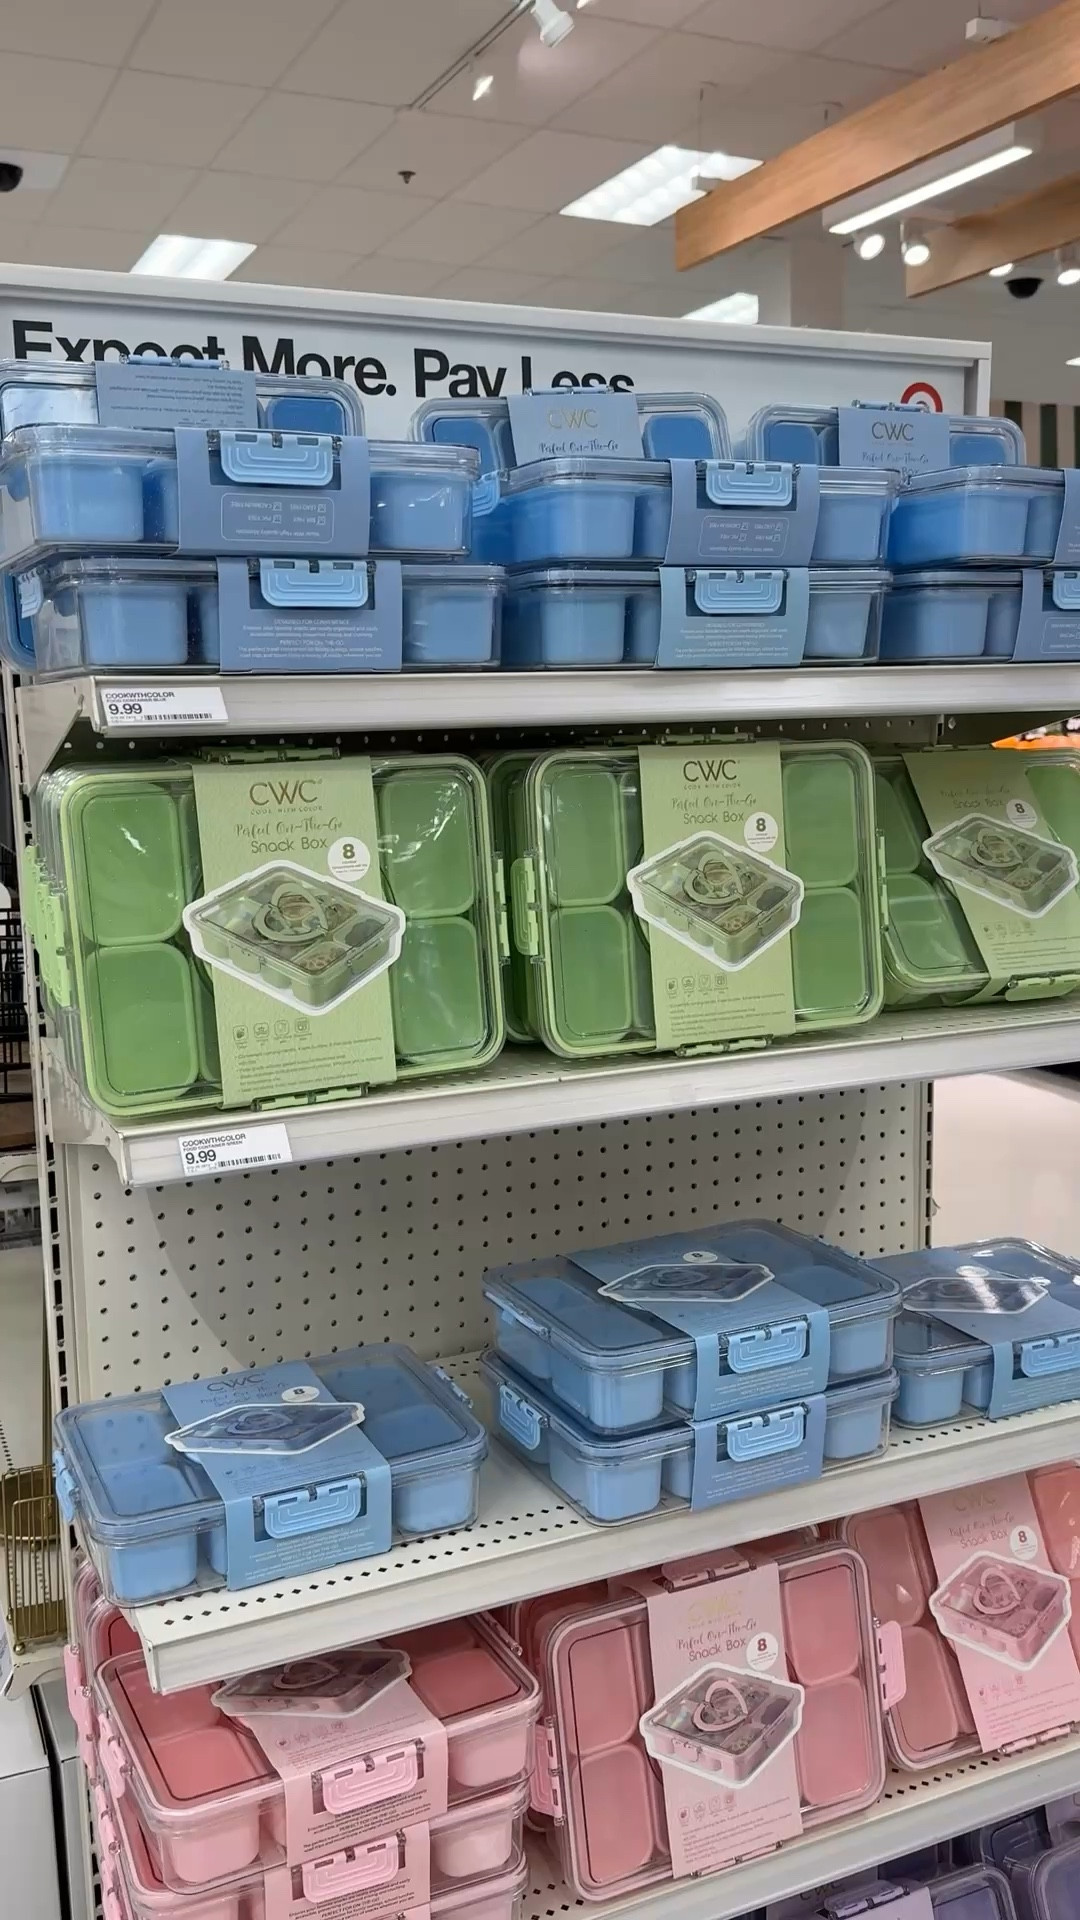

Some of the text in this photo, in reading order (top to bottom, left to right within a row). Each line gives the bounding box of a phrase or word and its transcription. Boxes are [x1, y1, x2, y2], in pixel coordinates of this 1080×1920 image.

[548, 408, 598, 429] CWC
[871, 421, 914, 441] CWC
[108, 703, 142, 715] 9.99
[682, 759, 737, 782] CWC
[249, 779, 318, 806] CWC
[1014, 803, 1025, 814] 8
[683, 810, 744, 825] Snack Box
[756, 817, 767, 832] 8
[250, 836, 328, 854] Snack Box
[342, 843, 356, 860] 8
[182, 1132, 247, 1148] COOKWTHCOLOR
[185, 1149, 217, 1165] 9.99
[206, 1373, 265, 1392] CWC
[1018, 1530, 1028, 1543] 8
[689, 1638, 746, 1662] Snack Box
[757, 1638, 768, 1652] 8
